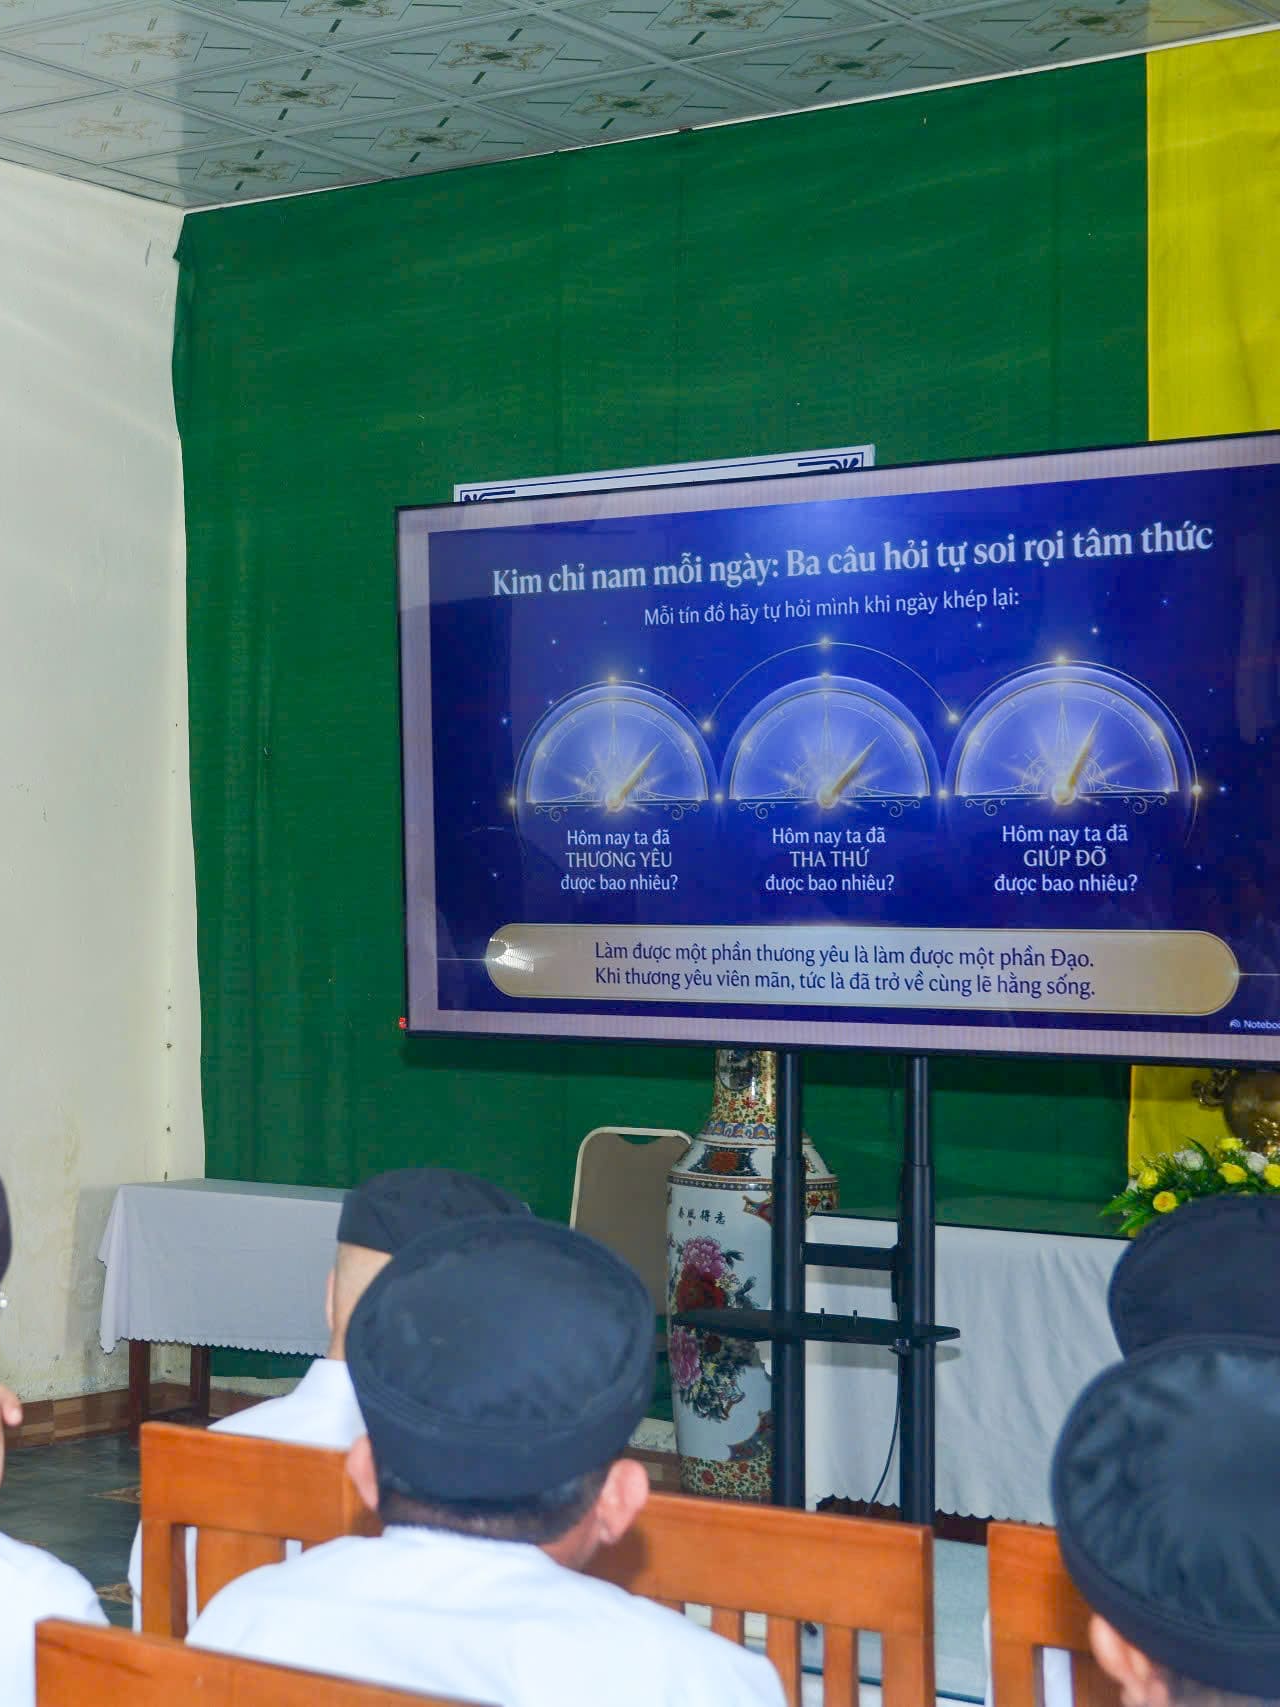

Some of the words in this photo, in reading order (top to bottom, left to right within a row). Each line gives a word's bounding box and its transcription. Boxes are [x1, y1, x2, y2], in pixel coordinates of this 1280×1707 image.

[492, 569, 542, 596] Kim
[548, 563, 585, 592] chỉ
[592, 567, 646, 590] nam
[653, 552, 702, 586] mỗi
[710, 552, 779, 588] ngày:
[786, 549, 821, 577] Ba
[828, 546, 876, 573] câu
[884, 540, 929, 570] hỏi
[936, 541, 968, 573] tự
[973, 534, 1016, 565] soi
[1024, 530, 1064, 567] rọi
[1072, 527, 1133, 558] tâm
[1141, 520, 1213, 553] thức
[644, 605, 674, 626] Mỗi
[679, 604, 699, 624] tín
[704, 602, 725, 622] đồ
[730, 603, 759, 624] hãy
[764, 602, 781, 623] tự
[785, 599, 811, 618] hỏi
[816, 596, 859, 616] mình
[865, 594, 890, 614] khi
[896, 592, 938, 616] ngày
[943, 588, 988, 612] khép
[992, 587, 1020, 610] lại:
[567, 829, 601, 845] Hôm
[605, 833, 631, 849] nay
[634, 831, 648, 845] ta
[652, 828, 671, 845] đã
[772, 827, 809, 844] Hôm
[814, 831, 842, 848] nay
[846, 829, 861, 844] ta
[866, 826, 886, 844] đã
[1002, 825, 1043, 842] Hôm
[1049, 829, 1079, 846] nay
[1084, 826, 1101, 841] ta
[1106, 824, 1128, 841] đã
[565, 850, 636, 868] THƯƠNG
[639, 848, 672, 868] YÊU
[789, 851, 826, 867] THA
[830, 846, 870, 867] THỨ
[1023, 845, 1070, 867] GIÚP
[1075, 846, 1106, 867] ĐỠ
[560, 874, 596, 894] được
[599, 874, 626, 891] bao
[630, 874, 679, 891] nhiêu?
[765, 873, 804, 894] được
[808, 874, 837, 891] bao
[841, 873, 895, 891] nhiêu?
[994, 874, 1037, 895] được
[1042, 874, 1073, 891] bao
[1079, 873, 1138, 892] nhiêu?
[595, 942, 627, 960] Làm
[632, 943, 671, 963] được
[676, 943, 707, 964] một
[712, 940, 751, 964] phần
[757, 944, 815, 966] thương
[820, 945, 849, 967] yêu
[854, 945, 869, 963] là
[874, 945, 904, 964] làm
[910, 946, 953, 968] được
[959, 946, 995, 969] một
[1000, 945, 1045, 970] phần
[1051, 948, 1094, 971] Đạo.
[596, 967, 620, 985] Khi
[625, 969, 680, 989] thương
[684, 970, 712, 990] yêu
[717, 969, 750, 988] viên
[755, 971, 795, 991] mãn,
[800, 970, 825, 989] tức
[831, 971, 845, 989] là
[849, 972, 870, 990] đã
[875, 972, 900, 991] trở
[904, 970, 924, 991] về
[929, 974, 972, 997] cùng
[977, 974, 992, 993] lẽ
[997, 972, 1042, 998] hằng
[1047, 974, 1096, 1000] sống.
